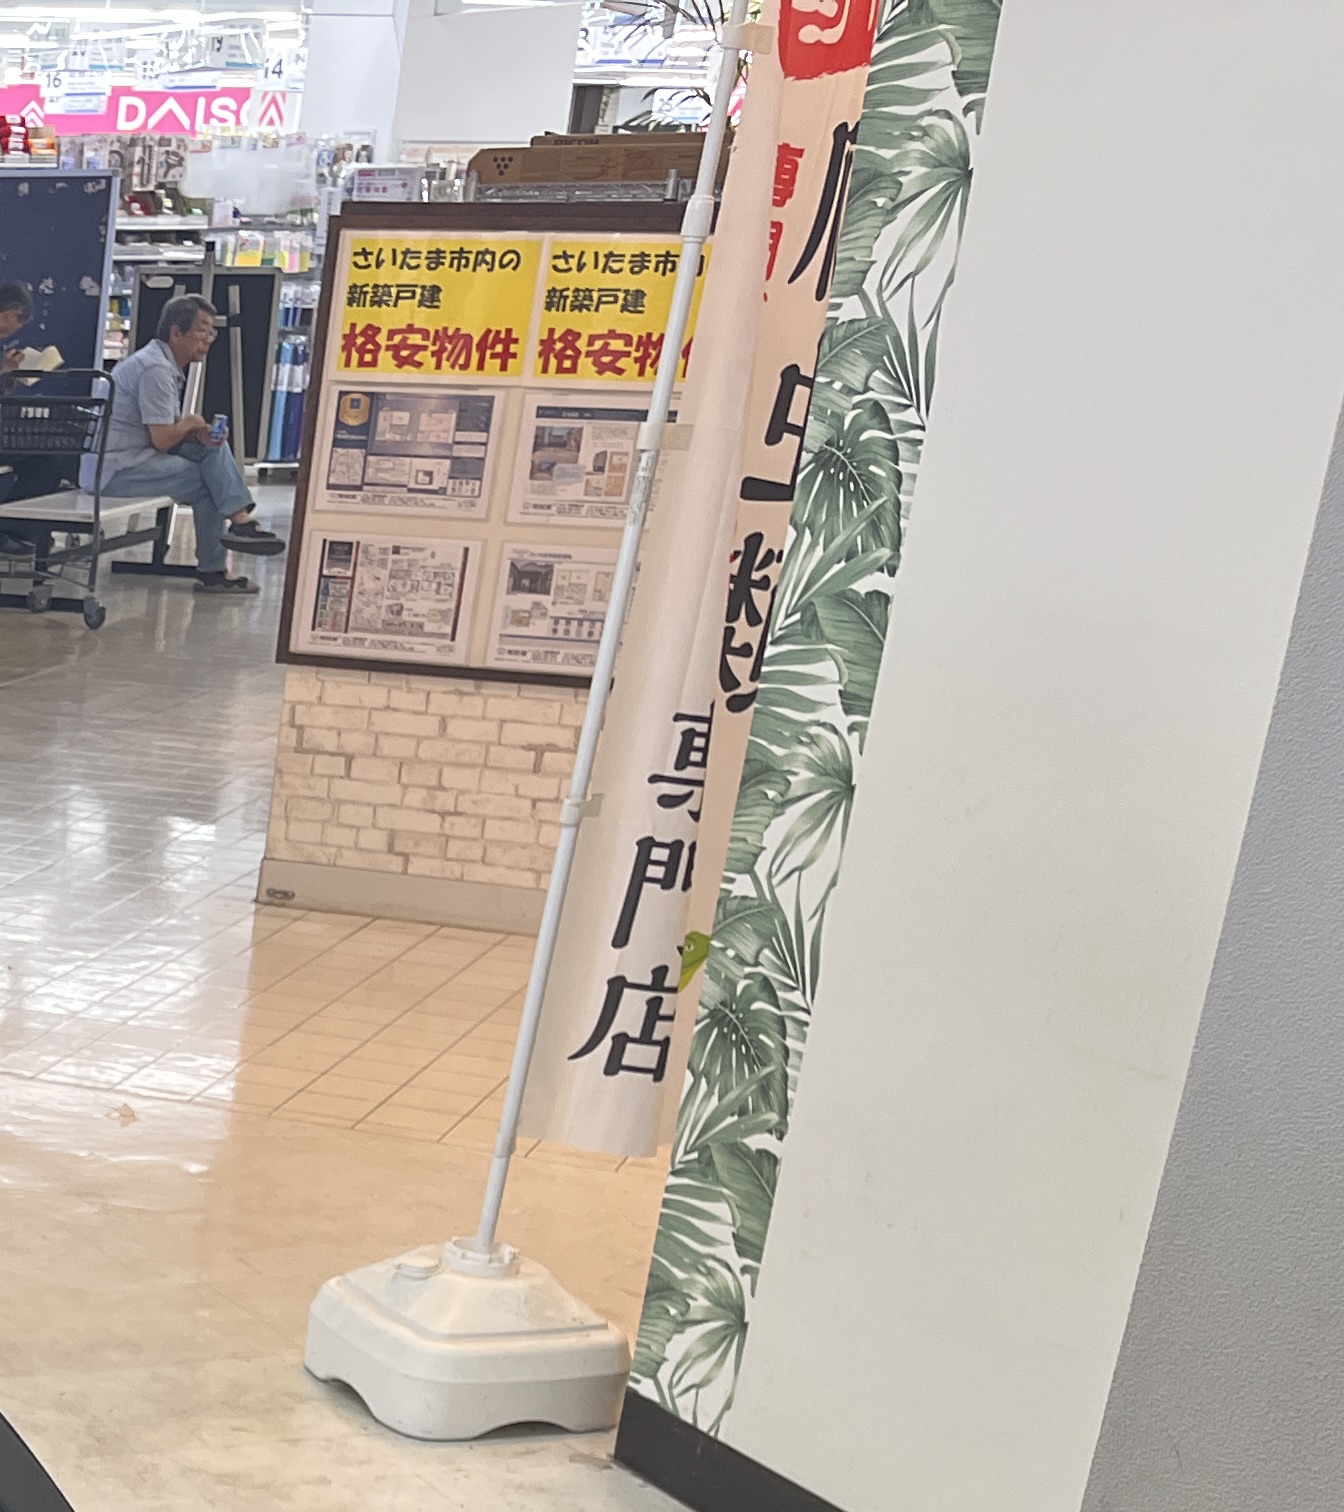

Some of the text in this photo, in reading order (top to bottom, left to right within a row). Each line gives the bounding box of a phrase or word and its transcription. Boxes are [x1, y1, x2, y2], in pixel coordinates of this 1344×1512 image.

[46, 72, 62, 89] 16
[351, 246, 522, 273] さいたま市内の
[551, 249, 705, 278] さいたま市
[346, 283, 443, 309] 新築戸建
[544, 287, 647, 315] 新築戸建
[341, 322, 519, 372] 格安物件
[538, 327, 694, 378] 格安物
